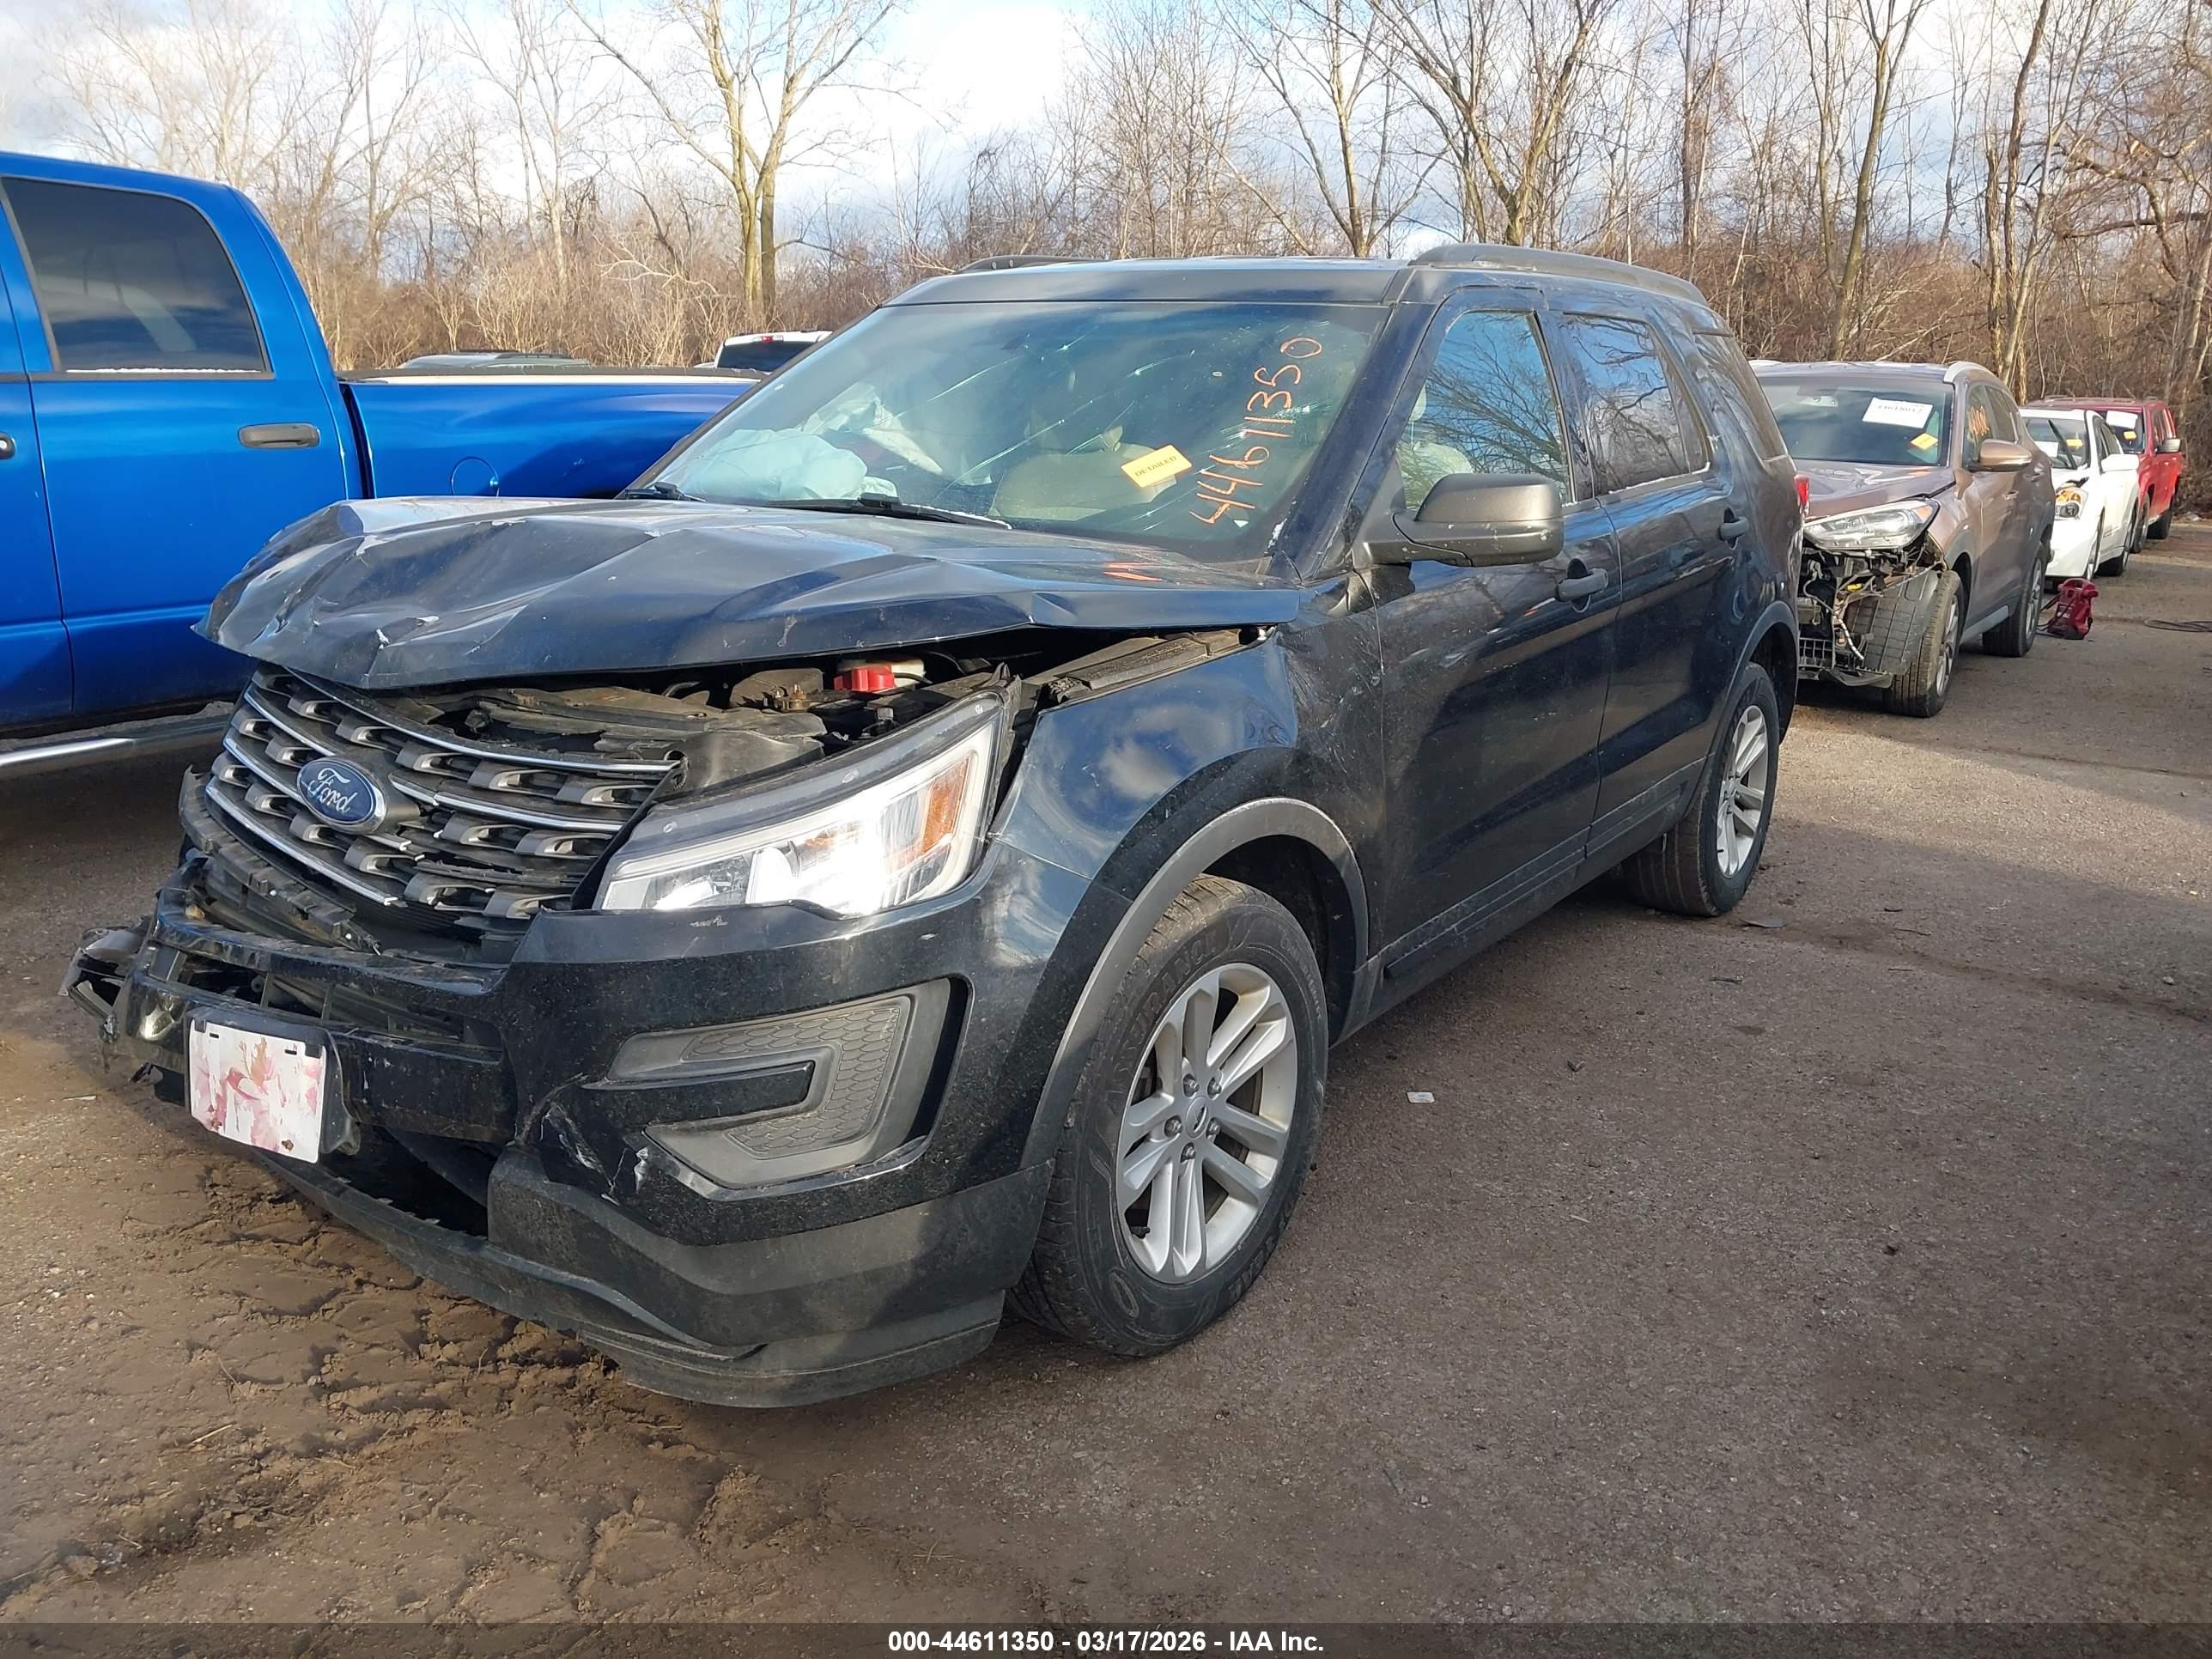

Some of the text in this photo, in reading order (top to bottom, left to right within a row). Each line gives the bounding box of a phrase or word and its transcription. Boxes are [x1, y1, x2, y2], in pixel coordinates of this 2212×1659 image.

[1189, 336, 1322, 525] 44611350
[1134, 455, 1176, 477] DETAILED
[301, 767, 358, 813] Ford
